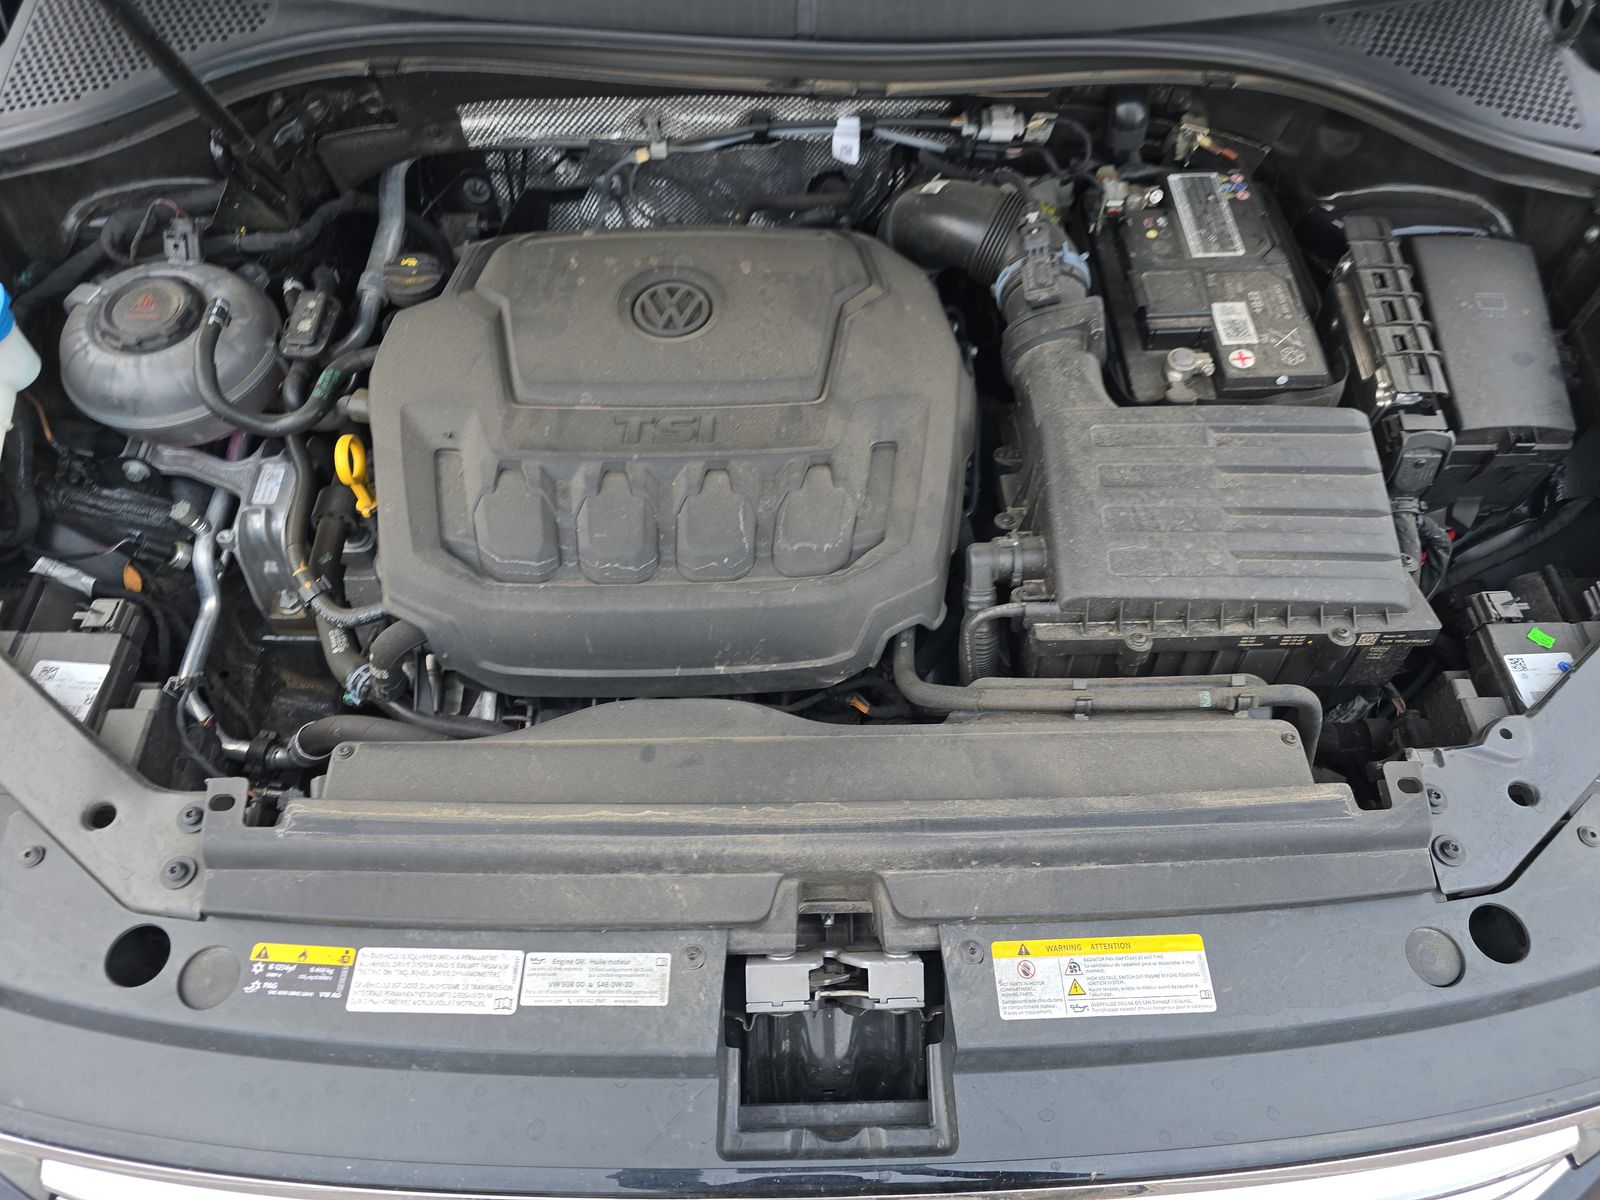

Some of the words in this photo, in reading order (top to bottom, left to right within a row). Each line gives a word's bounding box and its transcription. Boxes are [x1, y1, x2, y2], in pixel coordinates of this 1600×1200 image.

[612, 415, 717, 444] TSI
[1045, 943, 1082, 952] WARNING
[1090, 942, 1131, 950] ATTENTION
